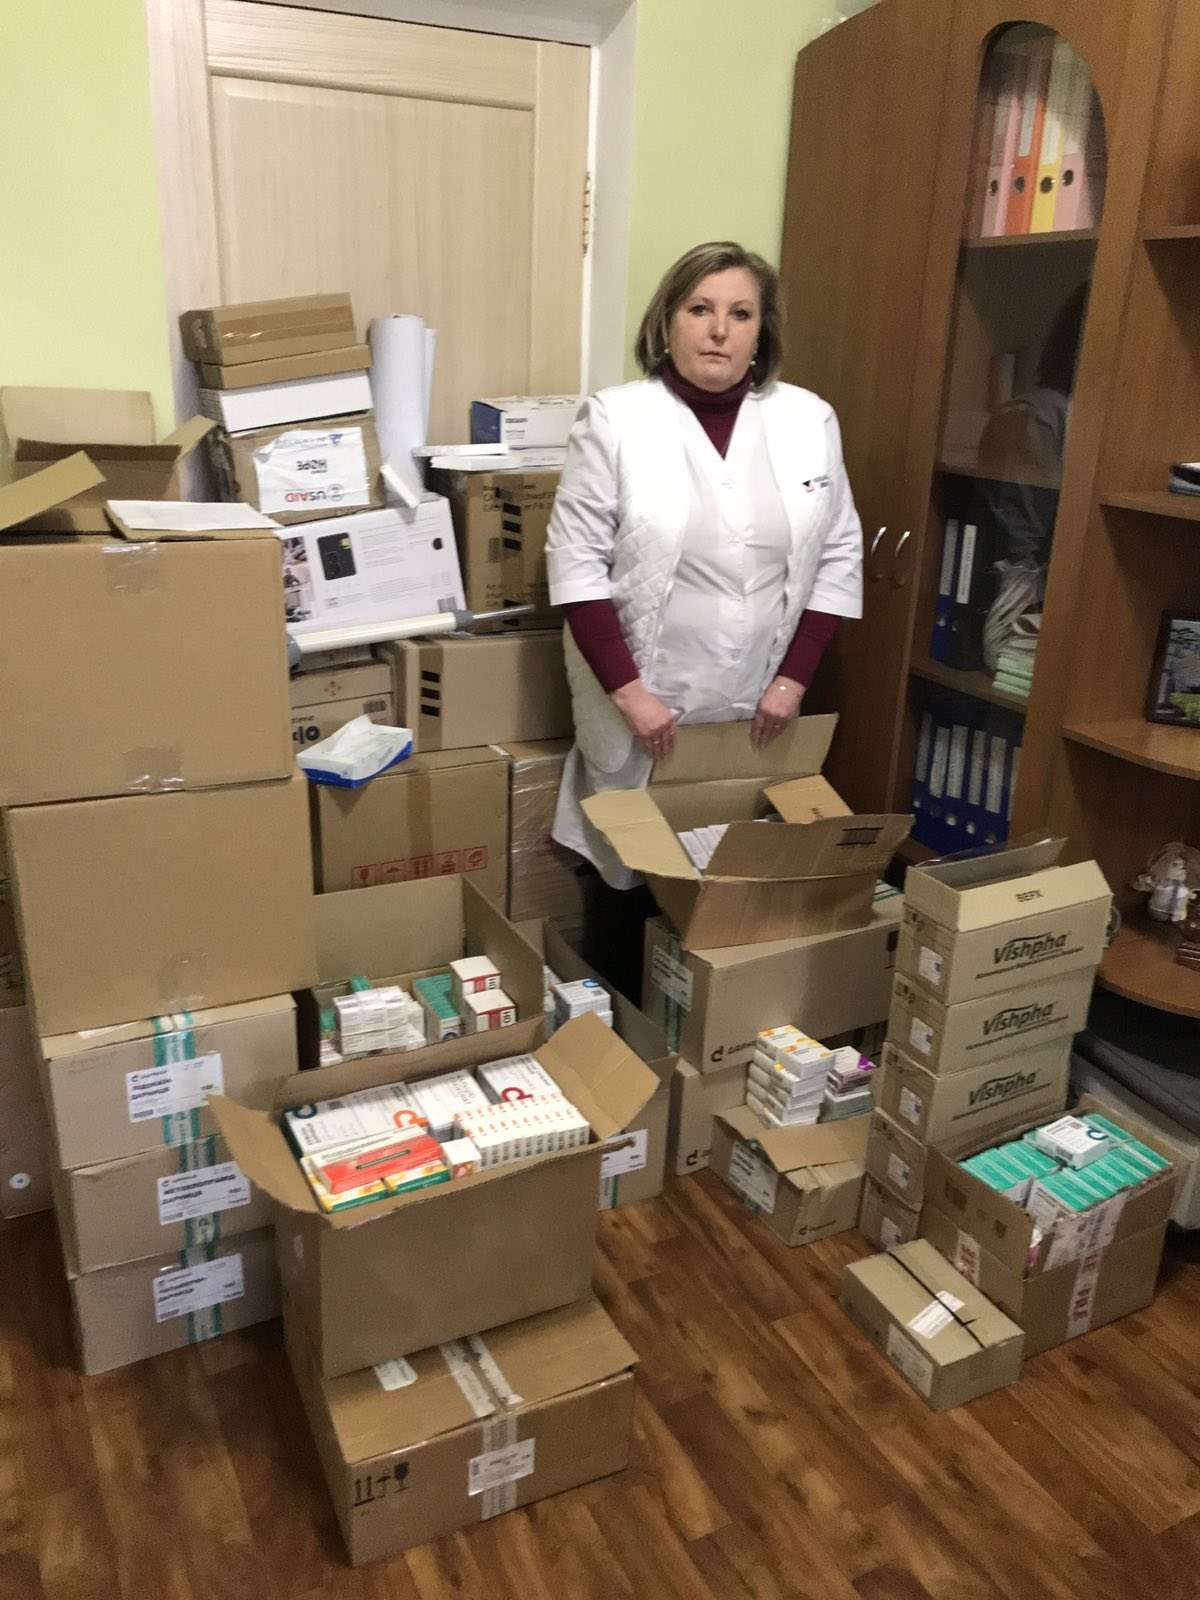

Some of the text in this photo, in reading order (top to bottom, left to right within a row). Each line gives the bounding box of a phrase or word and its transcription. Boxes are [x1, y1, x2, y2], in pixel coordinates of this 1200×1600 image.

[284, 490, 328, 503] USAID
[992, 931, 1068, 965] Vishpha
[982, 1003, 1055, 1036] Vishpha
[968, 1071, 1037, 1107] Vishpha
